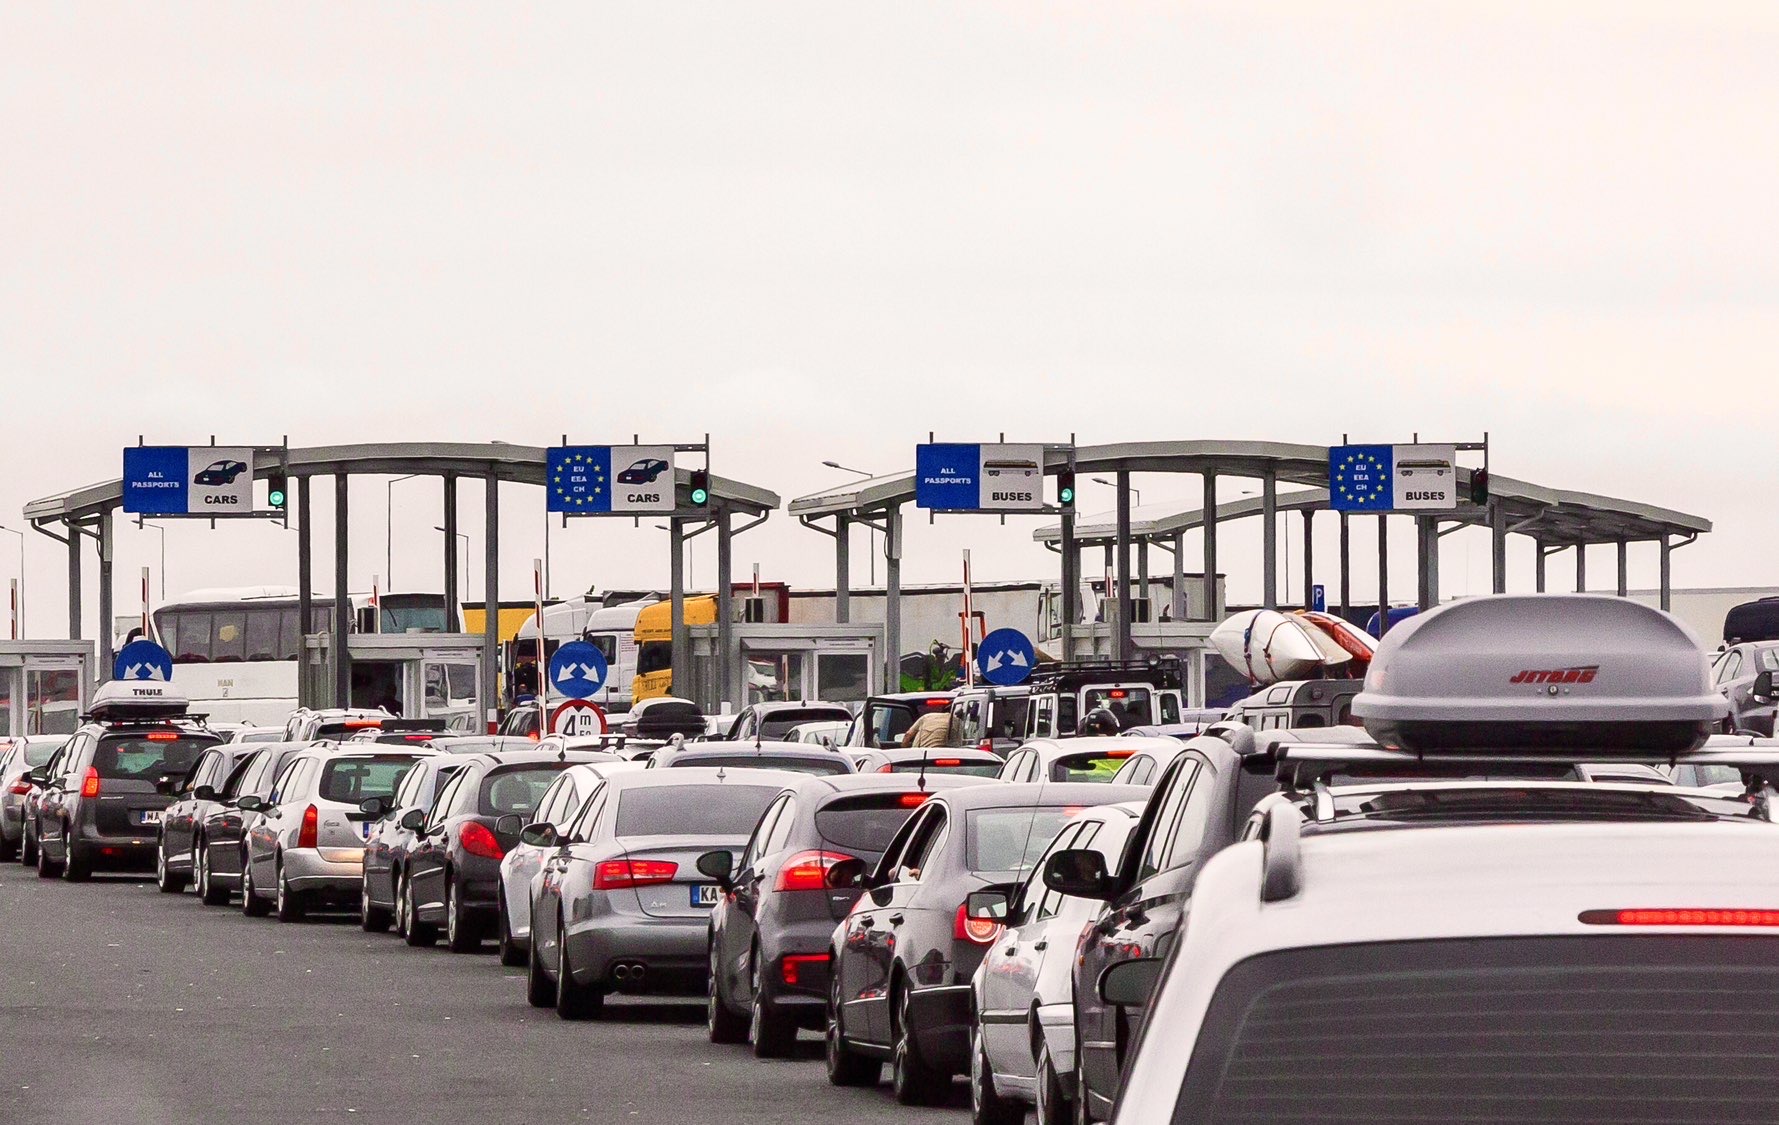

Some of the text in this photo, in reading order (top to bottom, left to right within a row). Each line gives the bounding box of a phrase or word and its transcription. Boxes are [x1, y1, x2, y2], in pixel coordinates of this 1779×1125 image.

[132, 481, 179, 489] PASSPORTS
[204, 495, 238, 504] CARS
[627, 493, 660, 503] CARS
[992, 492, 1032, 501] BUSES
[1405, 491, 1445, 501] BUSES
[1315, 588, 1323, 604] P
[132, 688, 163, 696] THULE
